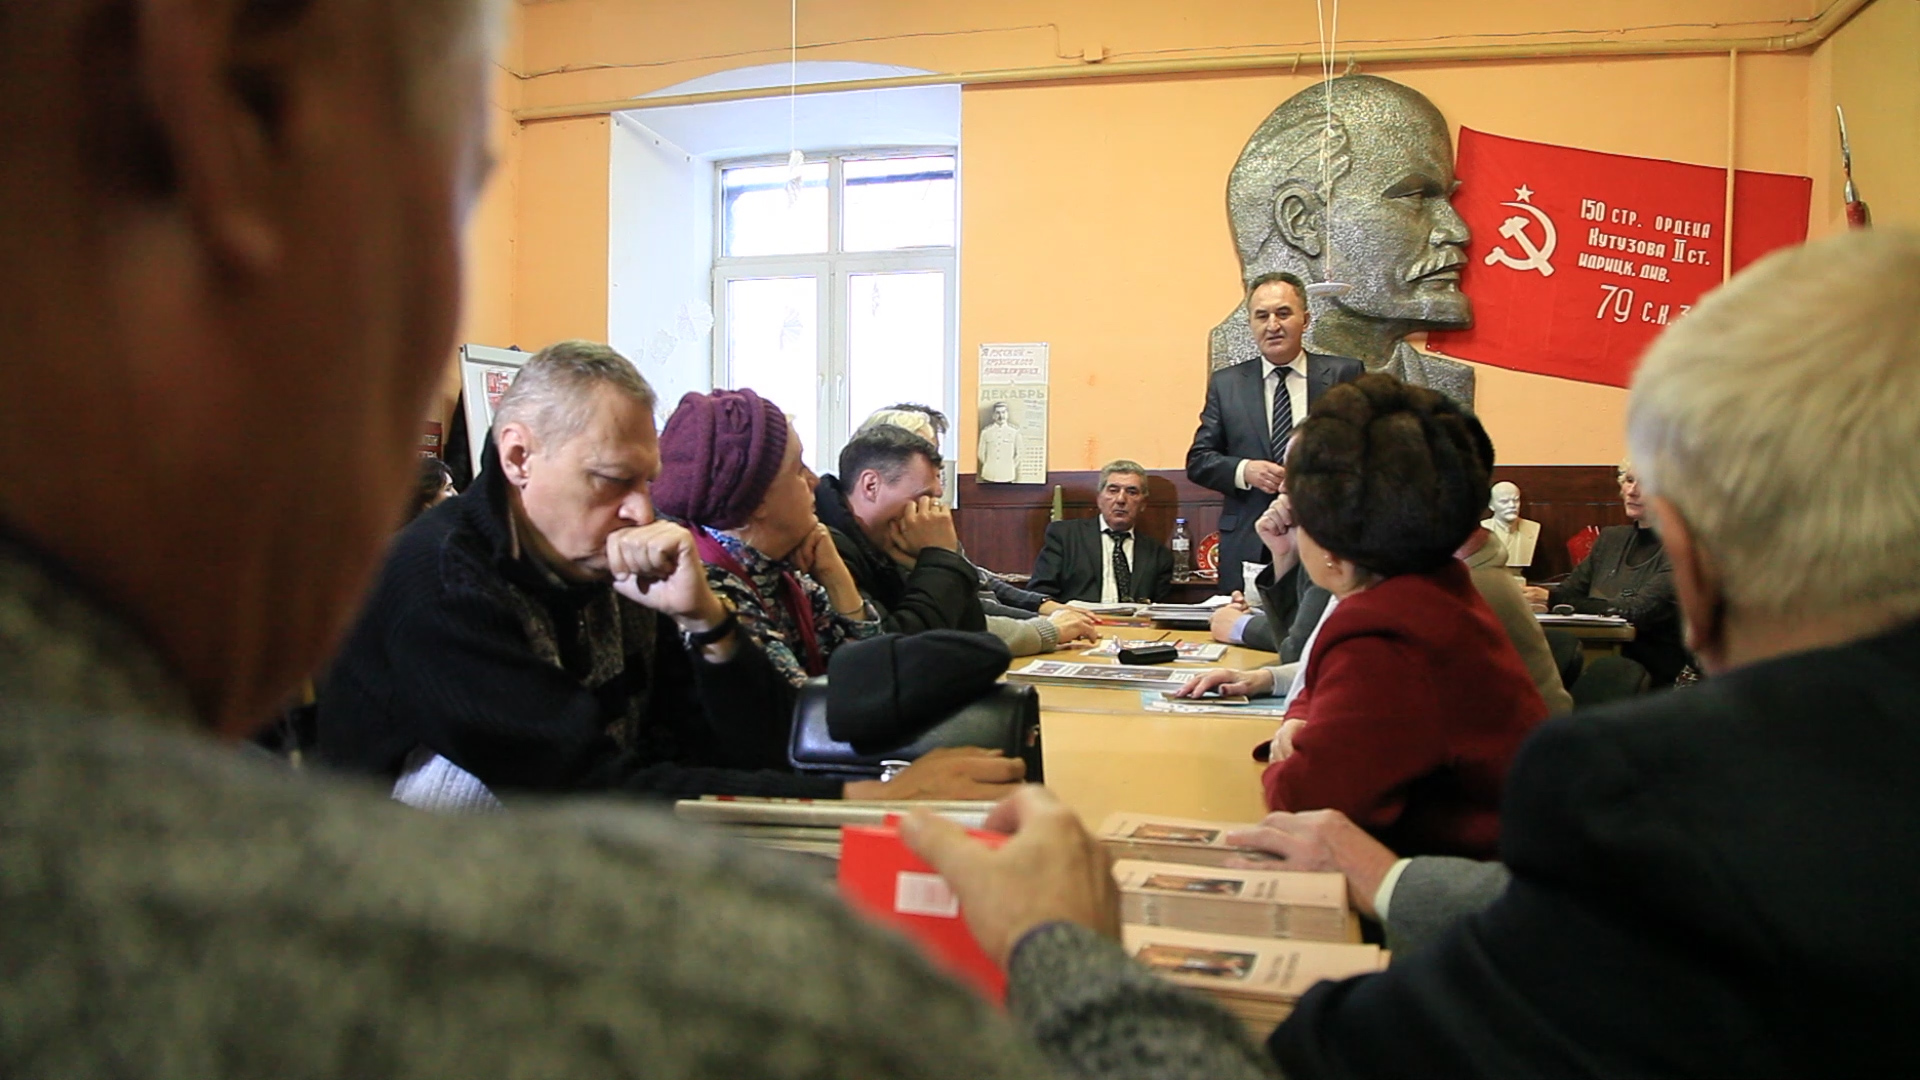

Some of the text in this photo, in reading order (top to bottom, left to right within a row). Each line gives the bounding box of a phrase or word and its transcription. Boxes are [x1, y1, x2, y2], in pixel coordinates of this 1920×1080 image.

[1581, 199, 1711, 239] 150 СТР. ОРДЕНА
[1578, 252, 1672, 283] ИДРИЦК. ДИВ.
[1671, 238, 1687, 263] II
[1688, 249, 1711, 266] СТ.
[1596, 284, 1634, 323] 79
[981, 389, 1045, 402] ДЕКАБРЬ
